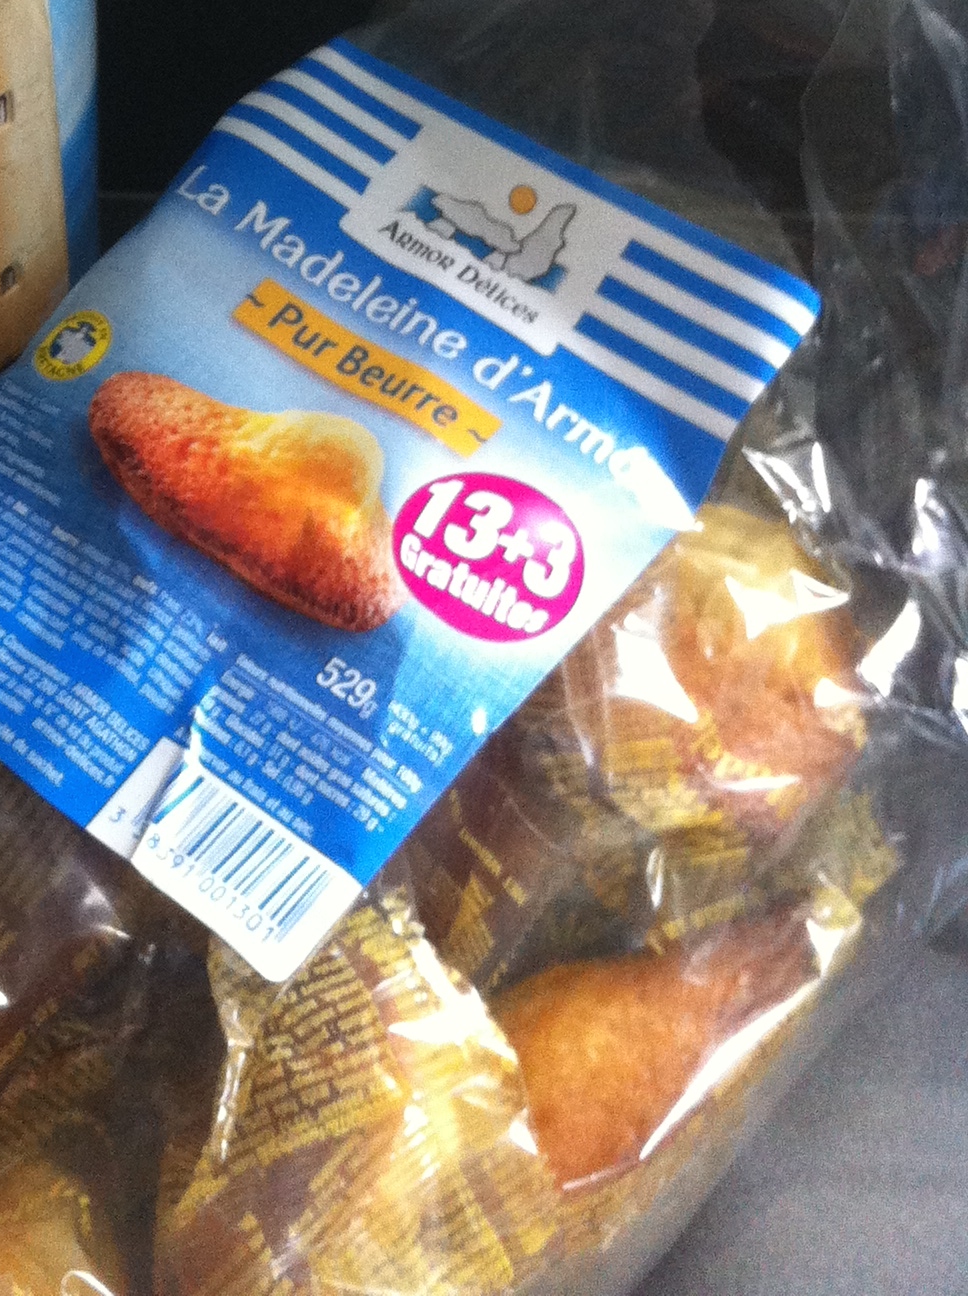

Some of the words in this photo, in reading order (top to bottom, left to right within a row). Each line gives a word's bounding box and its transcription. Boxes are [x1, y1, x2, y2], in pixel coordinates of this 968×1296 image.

[173, 163, 231, 218] La
[232, 198, 471, 366] Madeleine
[469, 351, 645, 486] d'Armo
[265, 300, 336, 363] Pur
[337, 343, 462, 432] Beurre
[394, 531, 550, 637] Gratuites
[411, 481, 580, 595] 13+3
